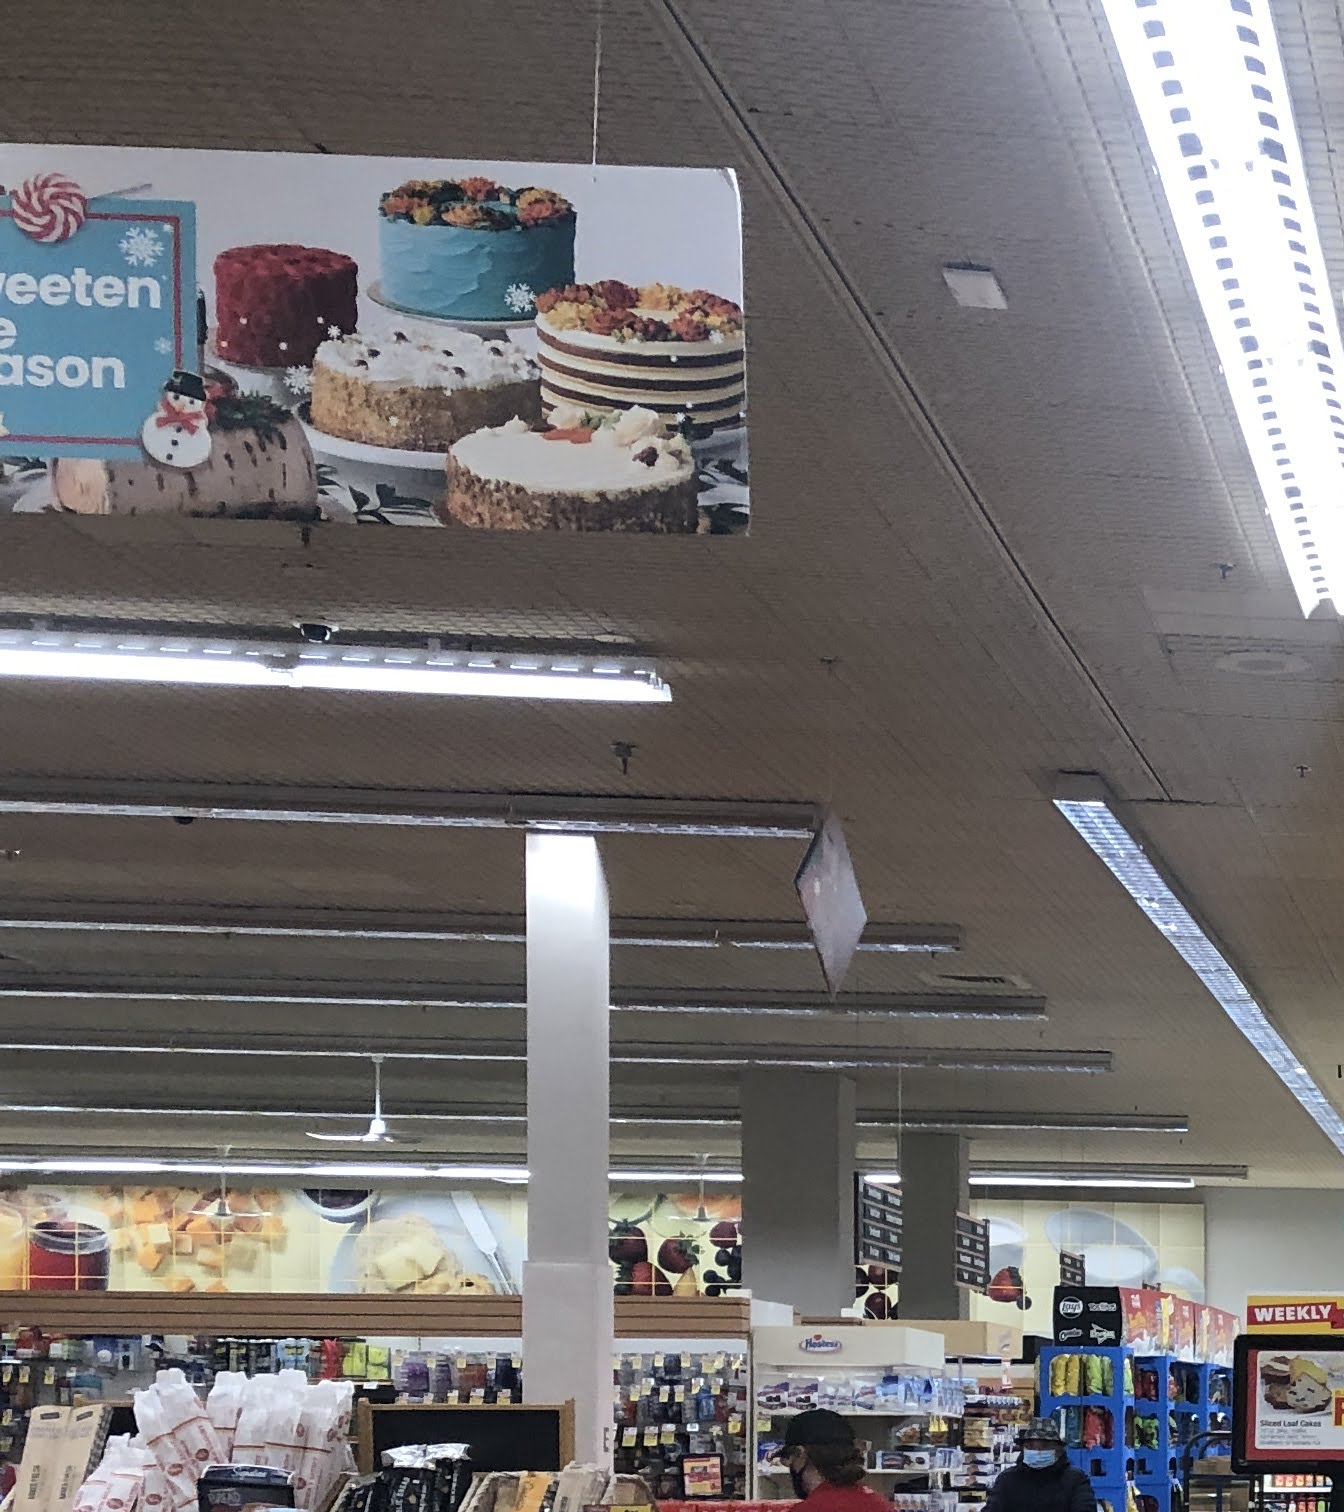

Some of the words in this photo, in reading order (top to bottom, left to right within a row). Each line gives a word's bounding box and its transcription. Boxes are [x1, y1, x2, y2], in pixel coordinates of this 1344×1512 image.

[0, 267, 162, 309] eeten
[0, 354, 126, 388] ason
[1254, 1304, 1332, 1322] WEEKLY
